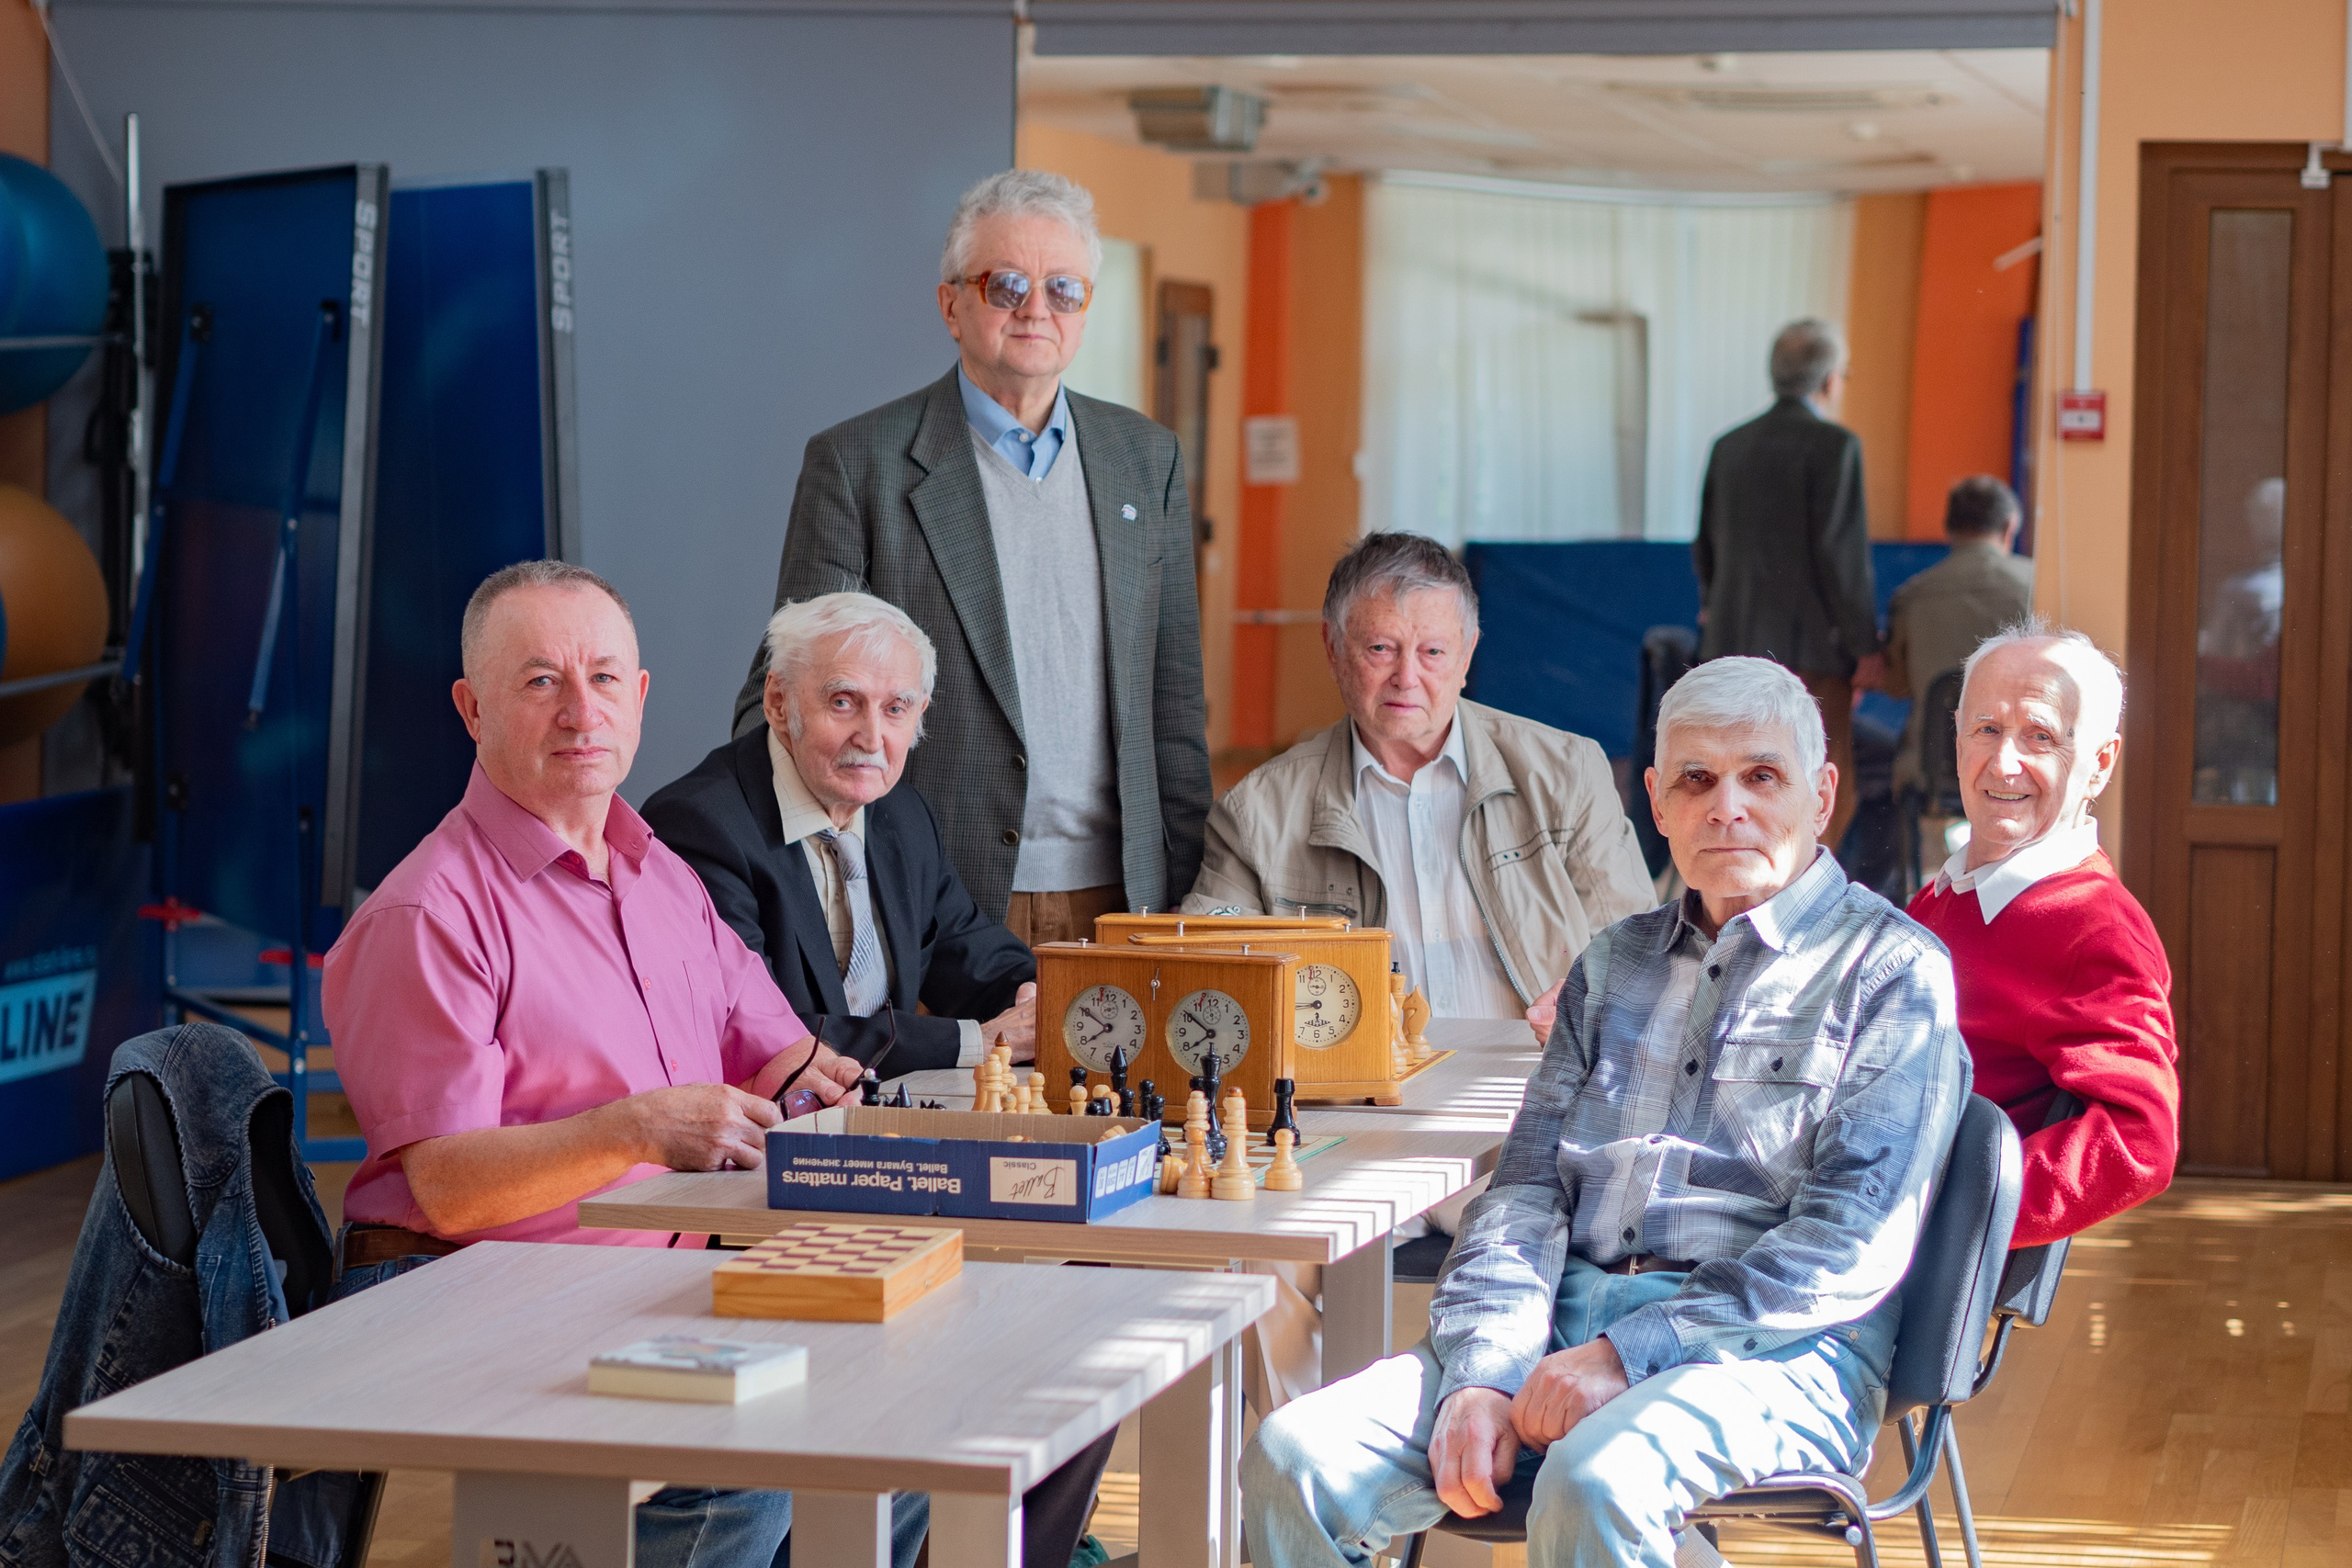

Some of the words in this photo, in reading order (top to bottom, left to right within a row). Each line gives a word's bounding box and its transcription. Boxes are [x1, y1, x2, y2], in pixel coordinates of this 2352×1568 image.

[350, 199, 378, 328] SPORT
[550, 209, 572, 333] SPORT
[1299, 975, 1305, 983] 11
[1312, 970, 1321, 978] 12
[1339, 985, 1346, 993] 2
[1091, 997, 1100, 1007] 11
[1105, 993, 1116, 1003] 12
[1207, 998, 1218, 1008] 12
[1342, 999, 1350, 1009] 3
[1130, 1010, 1137, 1021] 2
[1233, 1015, 1240, 1024] 2
[1339, 1014, 1346, 1022] 4
[0, 991, 85, 1062] LINE
[1076, 1021, 1084, 1031] 9
[1134, 1024, 1142, 1034] 3
[1299, 1026, 1305, 1035] 7
[1328, 1026, 1335, 1035] 5
[1178, 1027, 1186, 1037] 9
[1237, 1030, 1245, 1039] 3
[1313, 1030, 1320, 1039] 6
[1080, 1035, 1088, 1045] 8
[1129, 1039, 1136, 1048] 4
[1091, 1047, 1097, 1056] 7
[1182, 1042, 1190, 1051] 8
[1232, 1043, 1240, 1054] 4
[1104, 1053, 1112, 1063] 6
[1193, 1053, 1200, 1063] 7
[1223, 1054, 1230, 1064] 5
[792, 1156, 841, 1168] значение
[842, 1158, 874, 1168] имеет
[876, 1160, 913, 1173] Бумага
[1003, 1161, 1036, 1170] Classic
[916, 1162, 948, 1174] Ballet.
[782, 1170, 847, 1187] matters
[851, 1171, 903, 1191] Paper
[1008, 1165, 1065, 1200] Ballet
[908, 1176, 961, 1194] Ballet.
